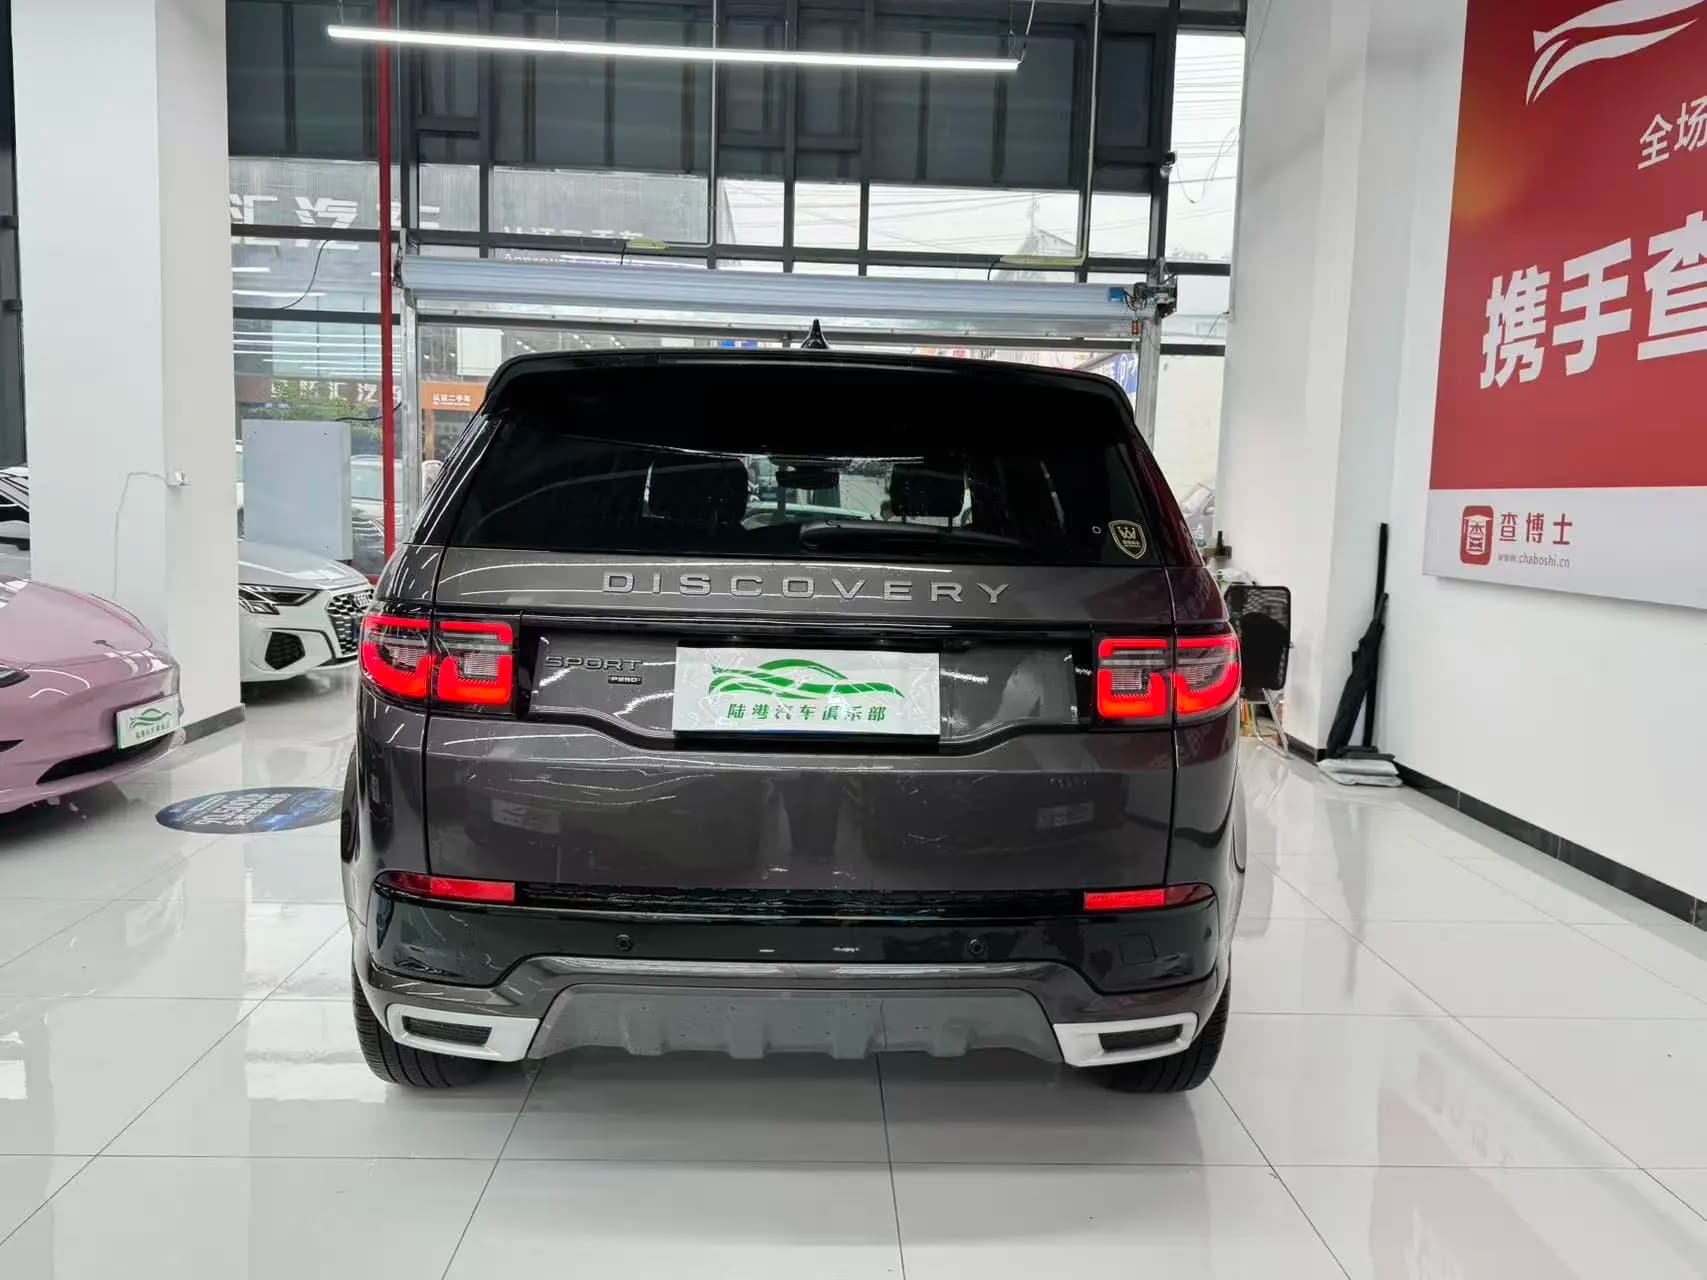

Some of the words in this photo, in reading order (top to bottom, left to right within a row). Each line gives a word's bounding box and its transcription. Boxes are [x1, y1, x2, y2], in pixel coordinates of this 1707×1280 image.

[1638, 95, 1707, 170] 全场
[1480, 210, 1707, 389] 携手查
[1499, 512, 1573, 546] 查博士
[1498, 552, 1571, 568] www.chaboshi.cn
[602, 571, 1009, 605] DISCOVERY
[545, 655, 643, 671] SPORT
[727, 703, 887, 722] 陆港汽车俱乐部
